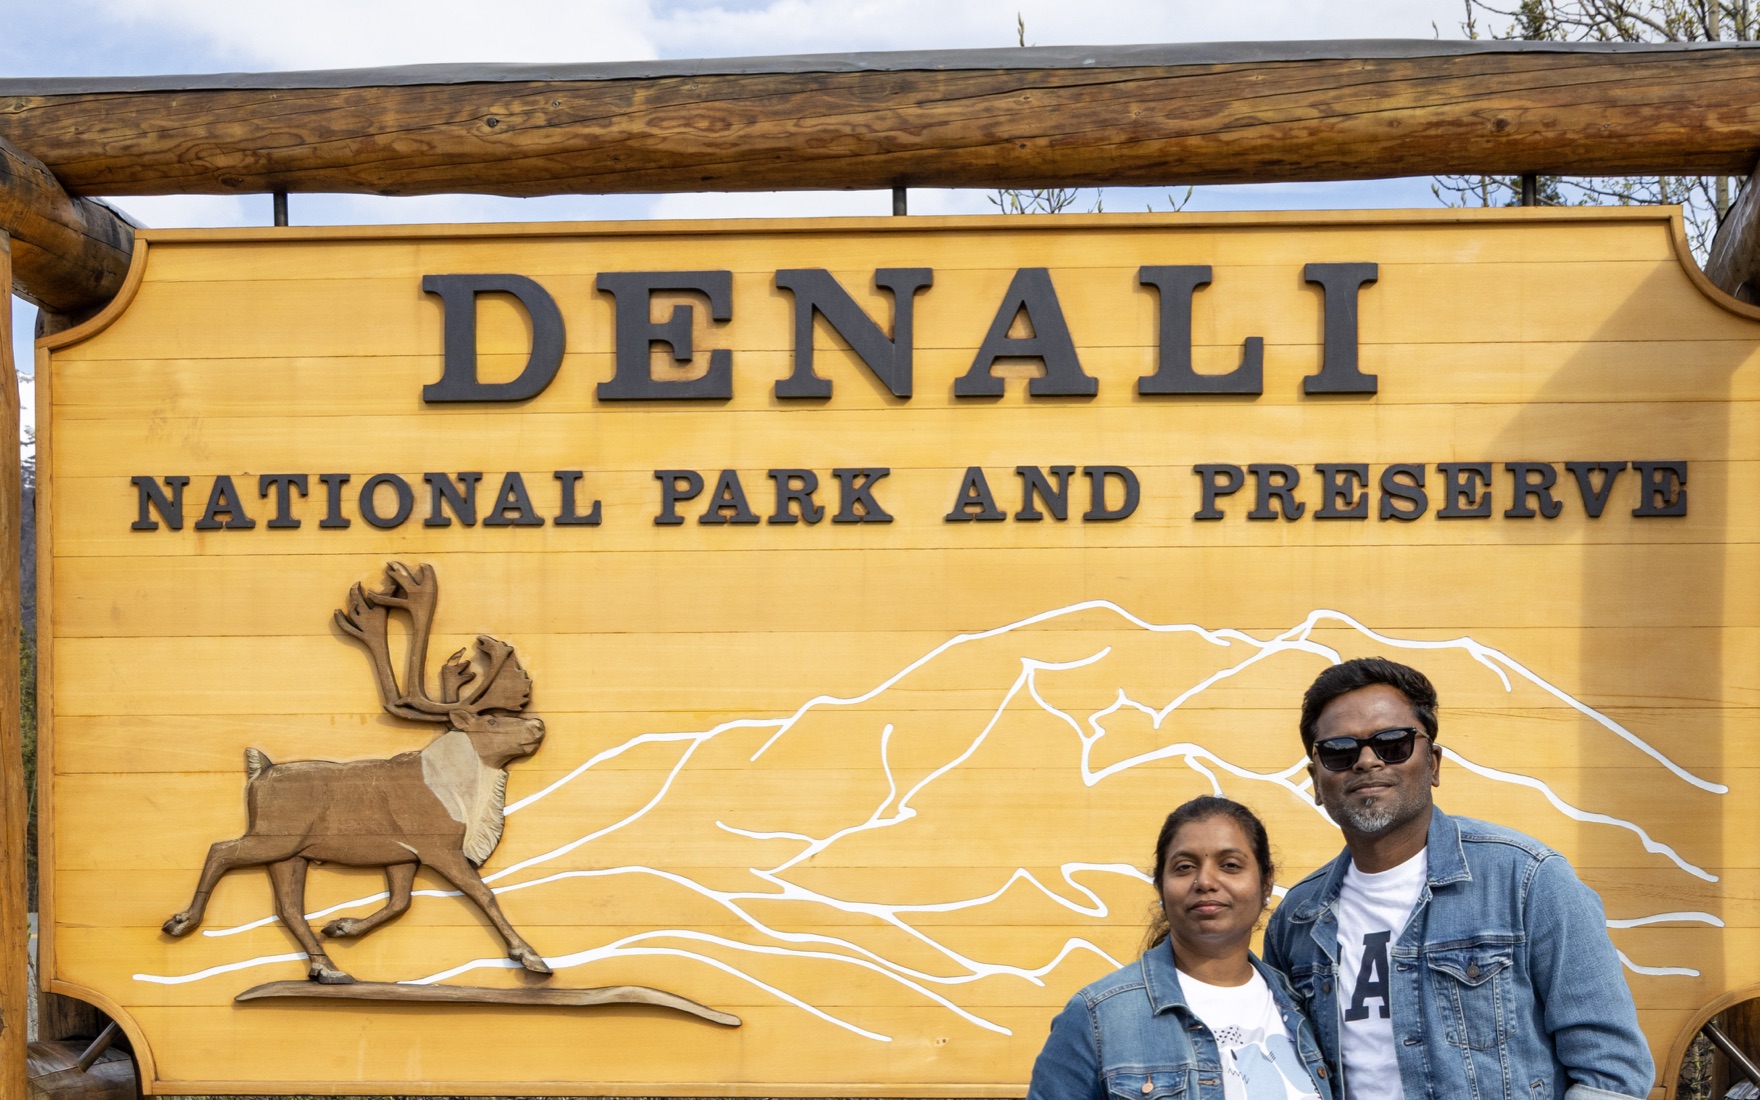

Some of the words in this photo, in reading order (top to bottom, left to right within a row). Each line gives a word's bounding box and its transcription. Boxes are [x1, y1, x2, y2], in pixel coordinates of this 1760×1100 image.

[422, 262, 1379, 406] DENALI
[131, 470, 602, 532] NATIONAL
[654, 467, 894, 527] PARK
[944, 465, 1140, 523] AND
[1194, 460, 1689, 522] PRESERVE
[1337, 930, 1391, 1022] A
